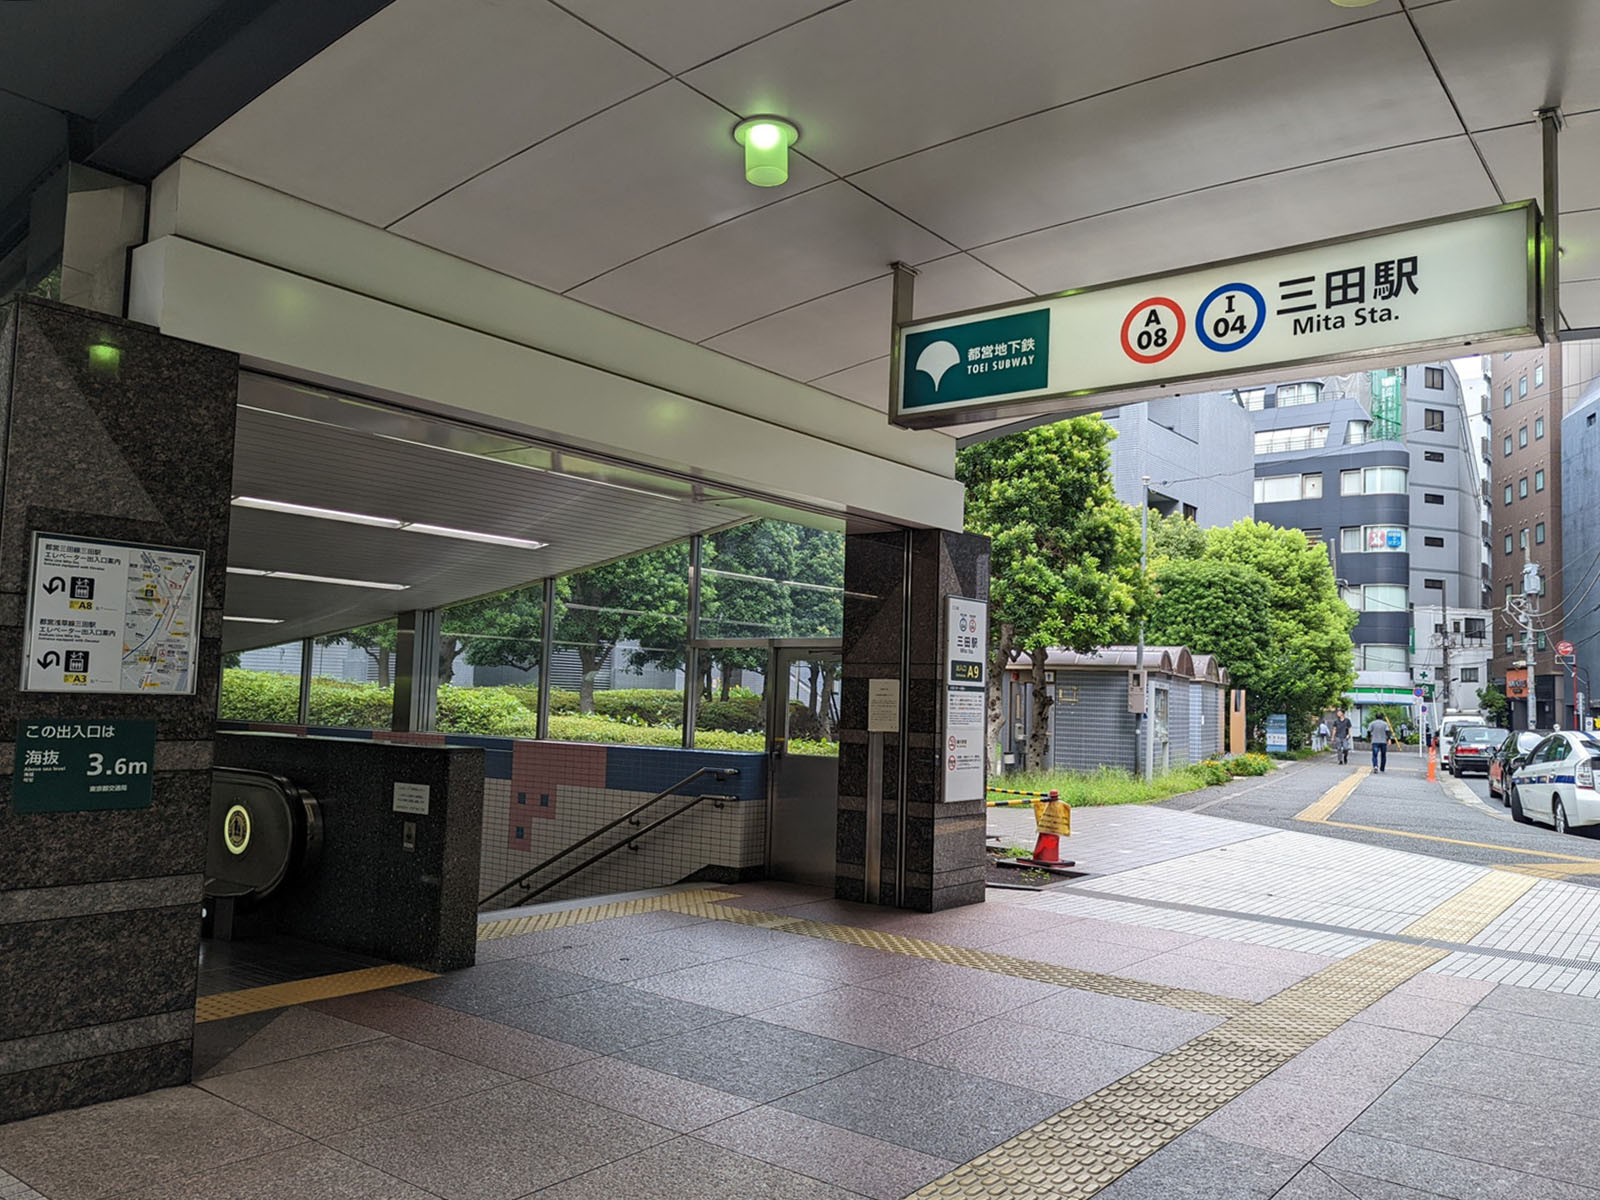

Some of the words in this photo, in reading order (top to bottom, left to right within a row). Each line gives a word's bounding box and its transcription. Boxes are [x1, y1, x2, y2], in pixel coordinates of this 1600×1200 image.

[1277, 255, 1419, 315] 三田駅
[1225, 295, 1236, 313] I
[1144, 309, 1161, 327] A
[1213, 314, 1246, 338] 04
[1292, 313, 1346, 336] Mita
[1354, 306, 1399, 326] Sta.
[1137, 327, 1168, 350] 08
[968, 337, 1036, 362] 都営地下鉄
[967, 362, 989, 375] TOEI
[992, 354, 1035, 371] SUBWAY
[45, 551, 121, 566] エレベーター出入口案内
[78, 601, 93, 610] A8
[39, 626, 116, 637] エレベーター出入口案内
[73, 674, 87, 683] A3
[967, 665, 979, 679] A9
[26, 725, 115, 739] この出入口は
[24, 750, 60, 765] 海抜
[86, 752, 148, 776] 3.6m
